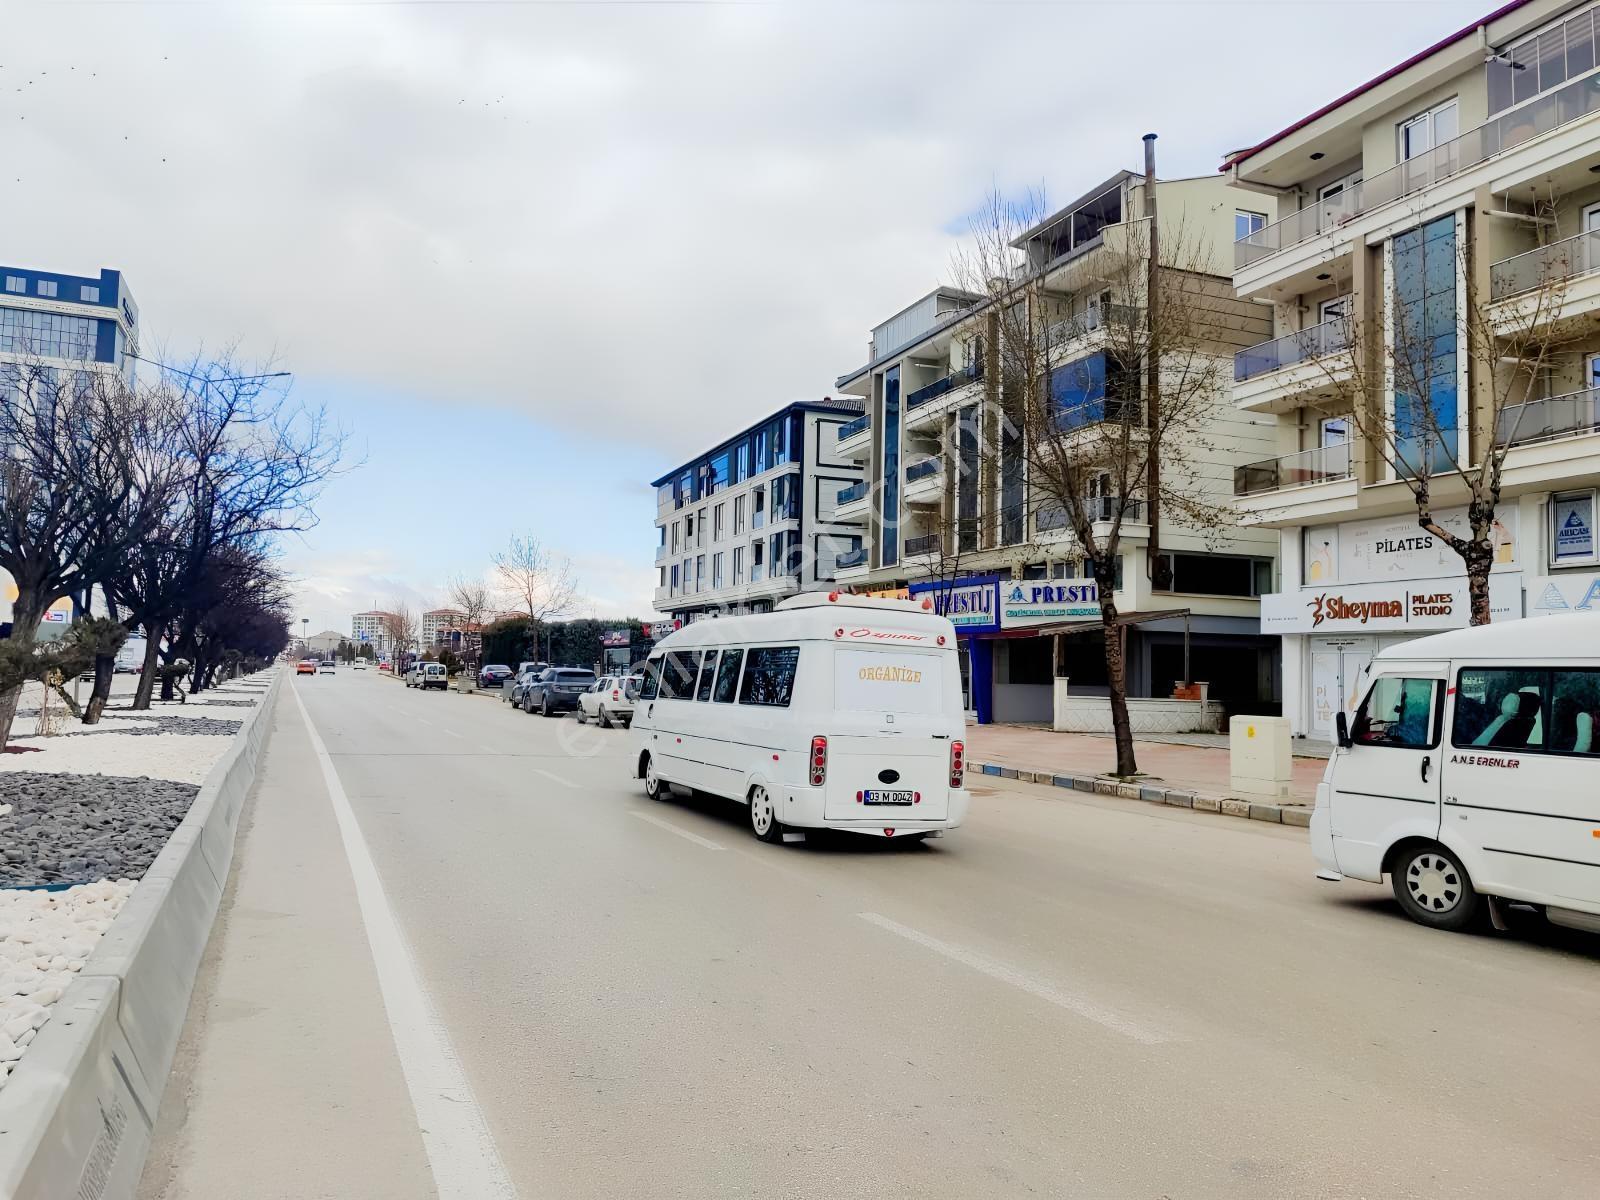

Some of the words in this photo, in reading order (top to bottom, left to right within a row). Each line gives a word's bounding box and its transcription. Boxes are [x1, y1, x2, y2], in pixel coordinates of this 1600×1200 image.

[1376, 537, 1433, 554] PİLATES
[1032, 583, 1097, 604] PRESTİ
[1326, 595, 1403, 624] Sheyma
[1412, 604, 1453, 616] STUDIO
[859, 665, 922, 683] ORGANİZE
[1476, 757, 1520, 769] ERENLER
[869, 792, 880, 801] 03
[882, 793, 890, 801] M
